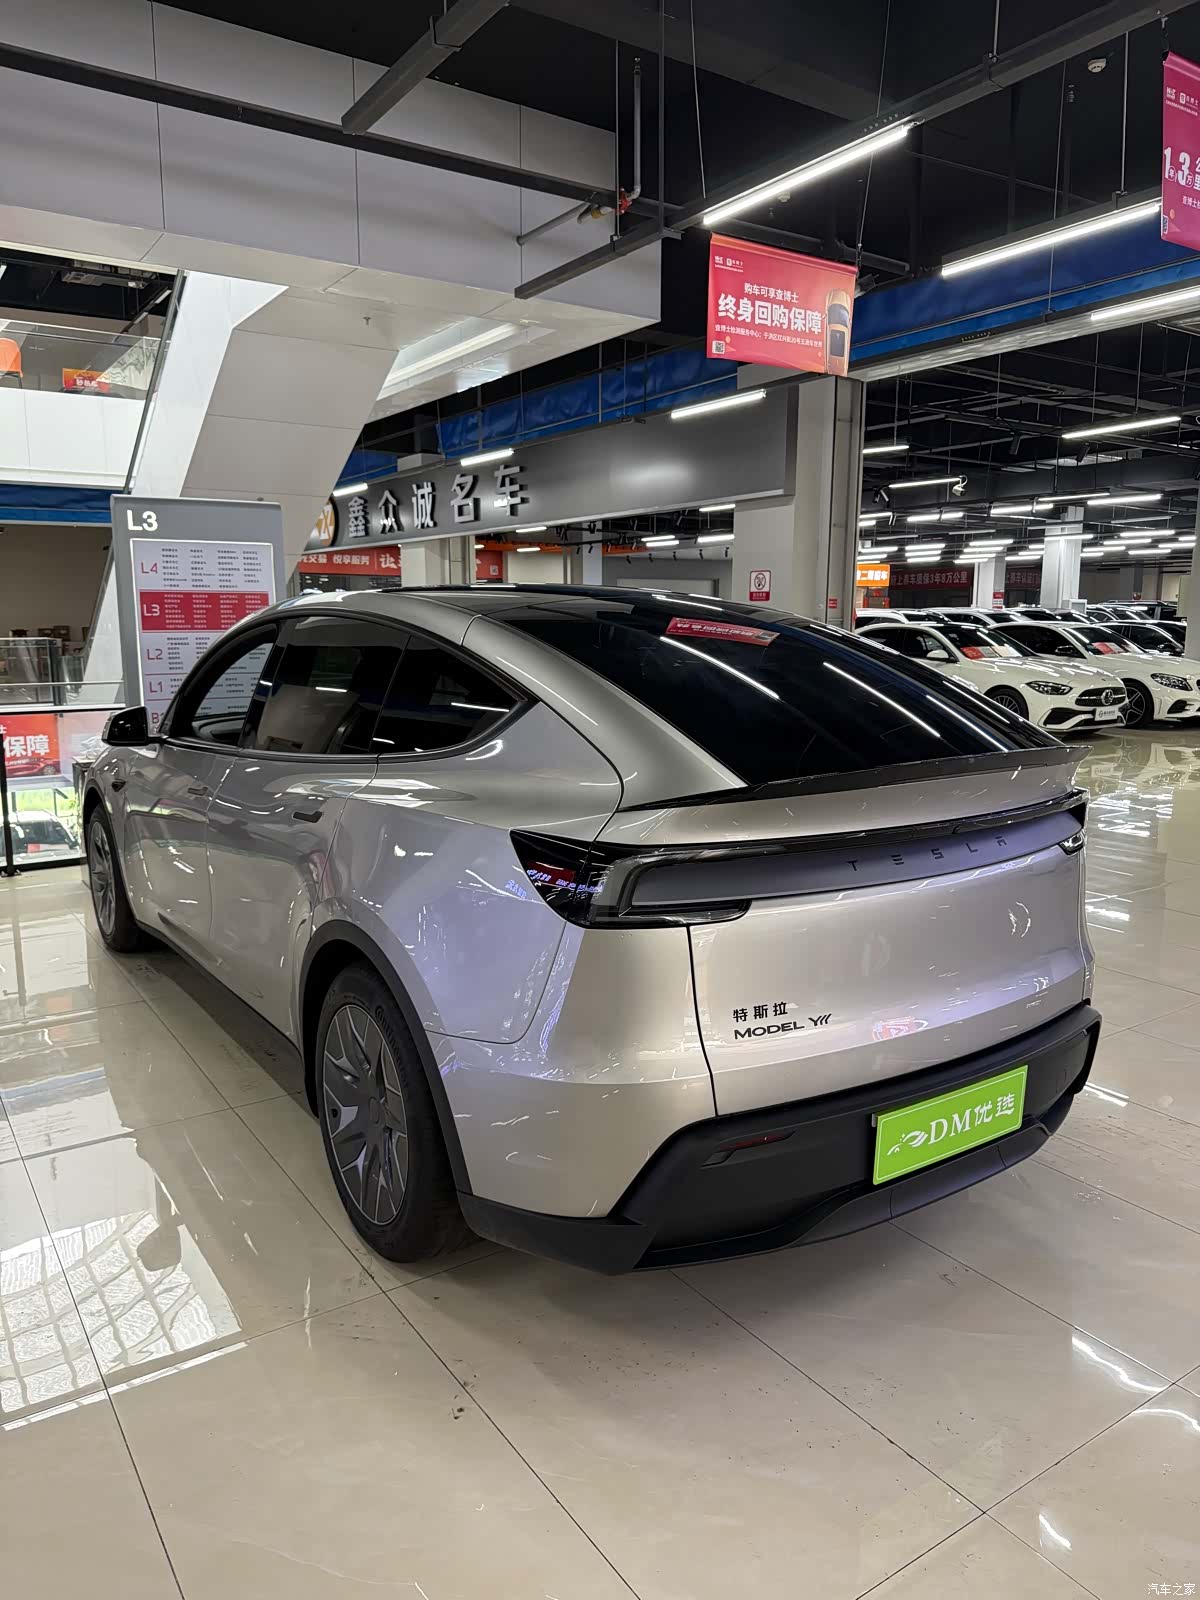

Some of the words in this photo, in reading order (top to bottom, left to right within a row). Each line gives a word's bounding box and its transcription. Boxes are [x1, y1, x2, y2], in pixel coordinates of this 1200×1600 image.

[744, 283, 799, 303] 购车可享查博士
[718, 293, 822, 335] 终身回购保障
[348, 464, 522, 538] 鑫众诚名车
[127, 510, 158, 531] L3
[141, 562, 158, 574] L4
[332, 554, 370, 566] 悦享服务
[379, 553, 401, 569] 让
[143, 604, 160, 616] L3
[147, 648, 163, 660] L2
[150, 681, 163, 693] L1
[3, 734, 50, 758] 保障
[847, 836, 1008, 872] TESLA
[733, 1001, 788, 1023] 特斯拉
[734, 1021, 805, 1040] MODEL
[928, 1092, 1015, 1145] DM优选
